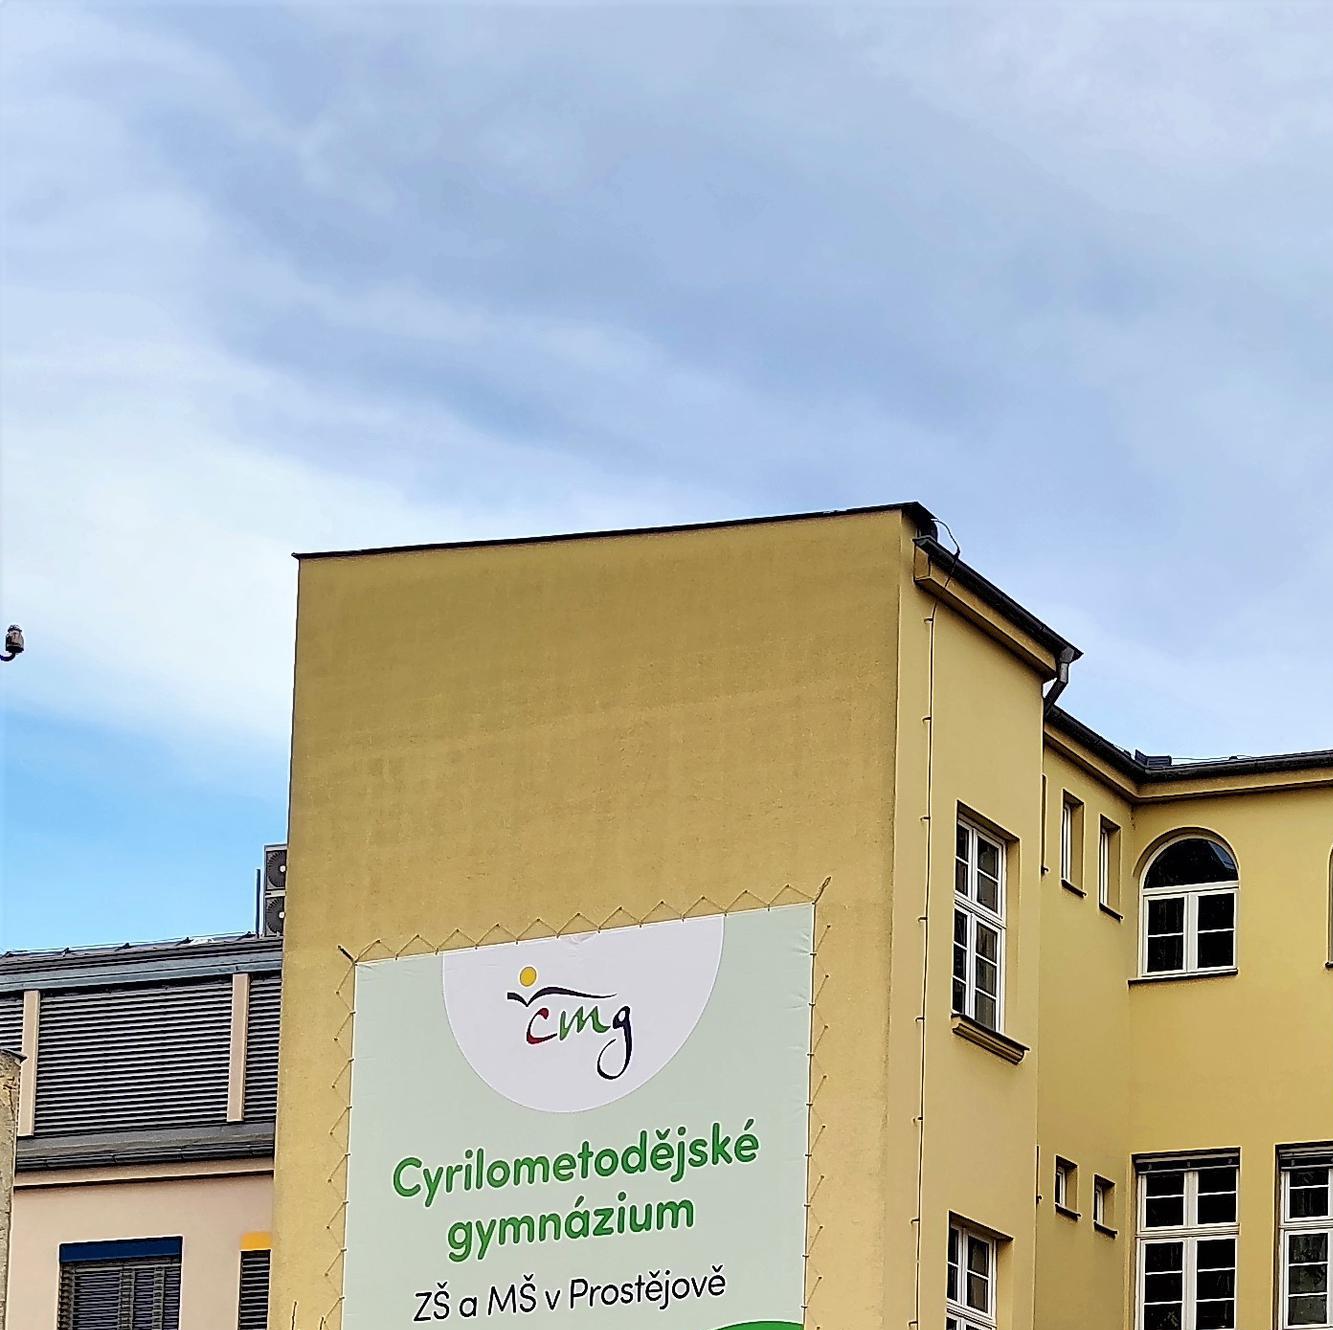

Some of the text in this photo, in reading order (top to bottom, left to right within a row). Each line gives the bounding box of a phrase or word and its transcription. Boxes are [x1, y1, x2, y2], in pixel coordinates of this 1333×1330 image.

[392, 1118, 761, 1207] Cyrilometodějské
[447, 1191, 696, 1263] gymnázium
[413, 1263, 726, 1322] ZŠ a MŠ v Prostějově
